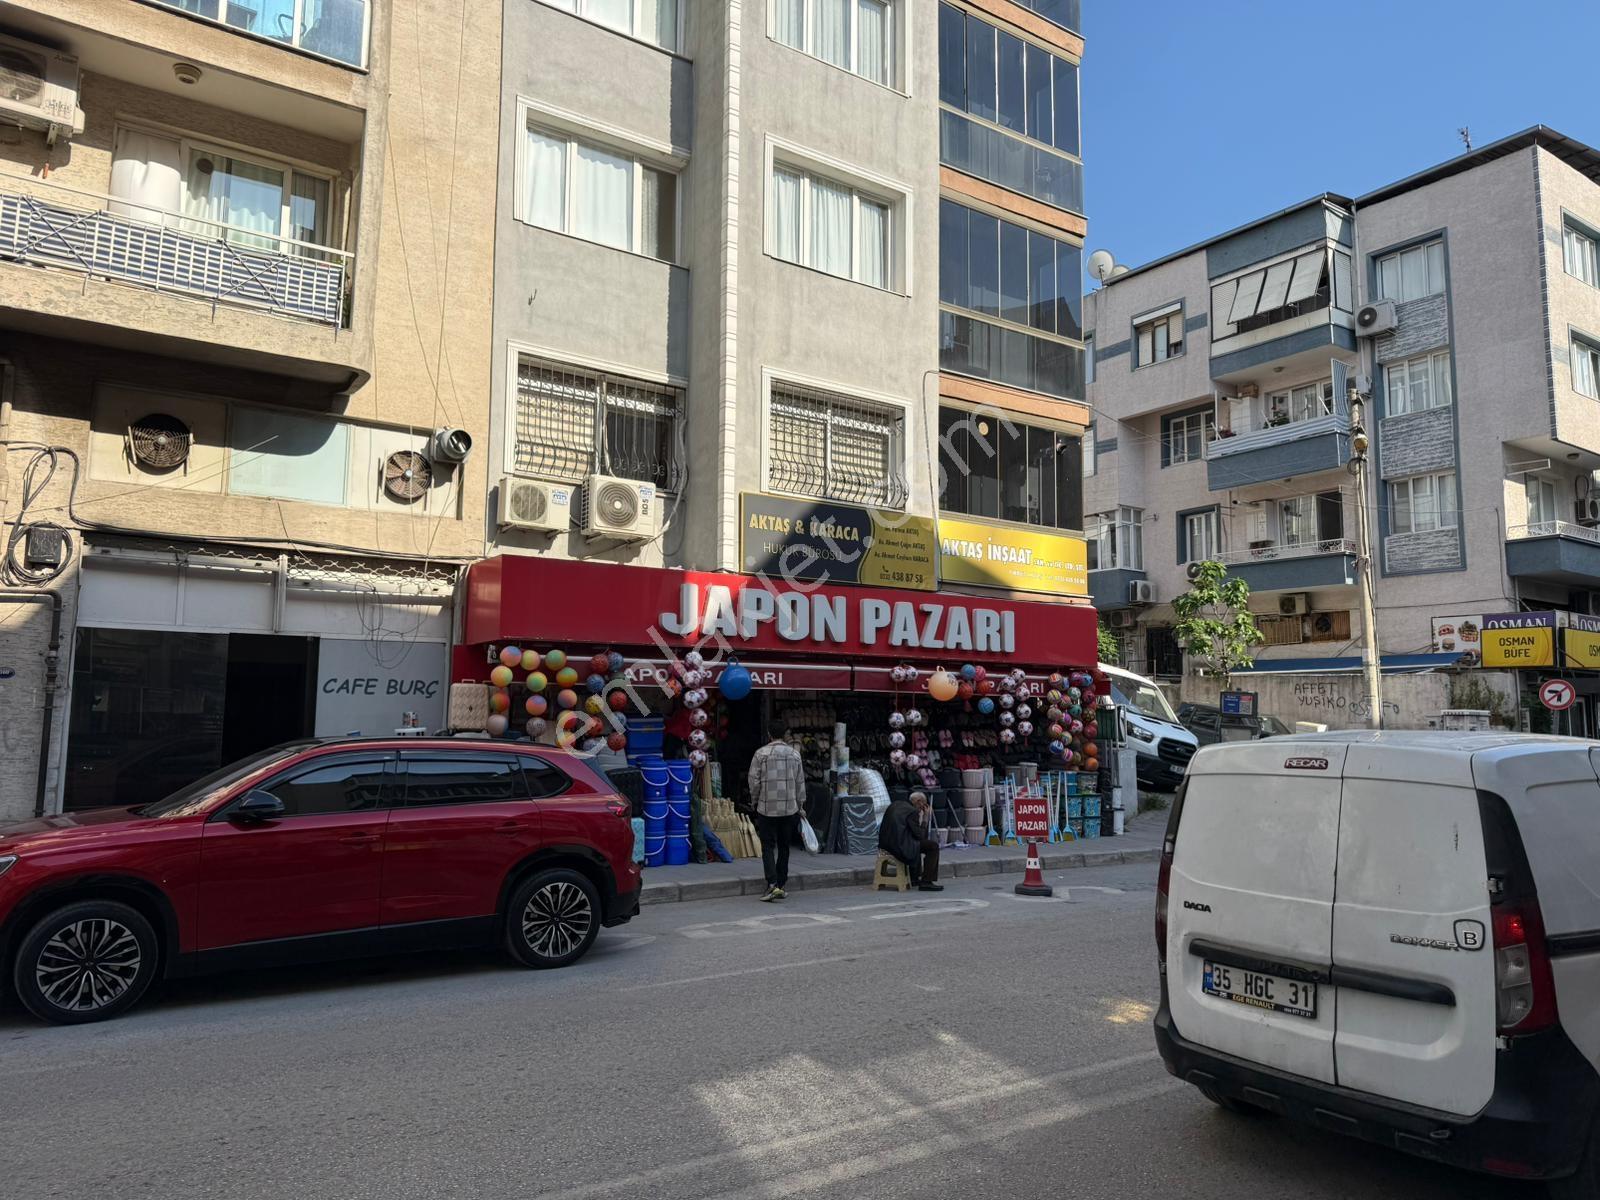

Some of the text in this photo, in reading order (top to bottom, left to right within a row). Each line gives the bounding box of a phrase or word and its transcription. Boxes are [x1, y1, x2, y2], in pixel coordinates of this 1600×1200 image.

[749, 513, 859, 541] AKTAŞ & KARACA
[941, 538, 983, 562] AKTAŞ
[987, 537, 1032, 565] İNŞAAT
[660, 583, 1015, 652] JAPON PAZARI
[1499, 636, 1535, 647] OSMAN
[1504, 647, 1531, 658] BÜFE
[323, 678, 439, 699] CAFE BURÇ
[1294, 682, 1337, 695] AFFET
[1285, 759, 1327, 769] RECAR
[1017, 804, 1046, 815] JAPON
[1017, 821, 1047, 831] PAZARI
[1184, 901, 1211, 913] DACIA
[1463, 931, 1478, 946] B
[1213, 967, 1309, 1008] 35 HGC 31
[1232, 994, 1245, 1003] EGE
[1245, 996, 1276, 1010] RENAULT
